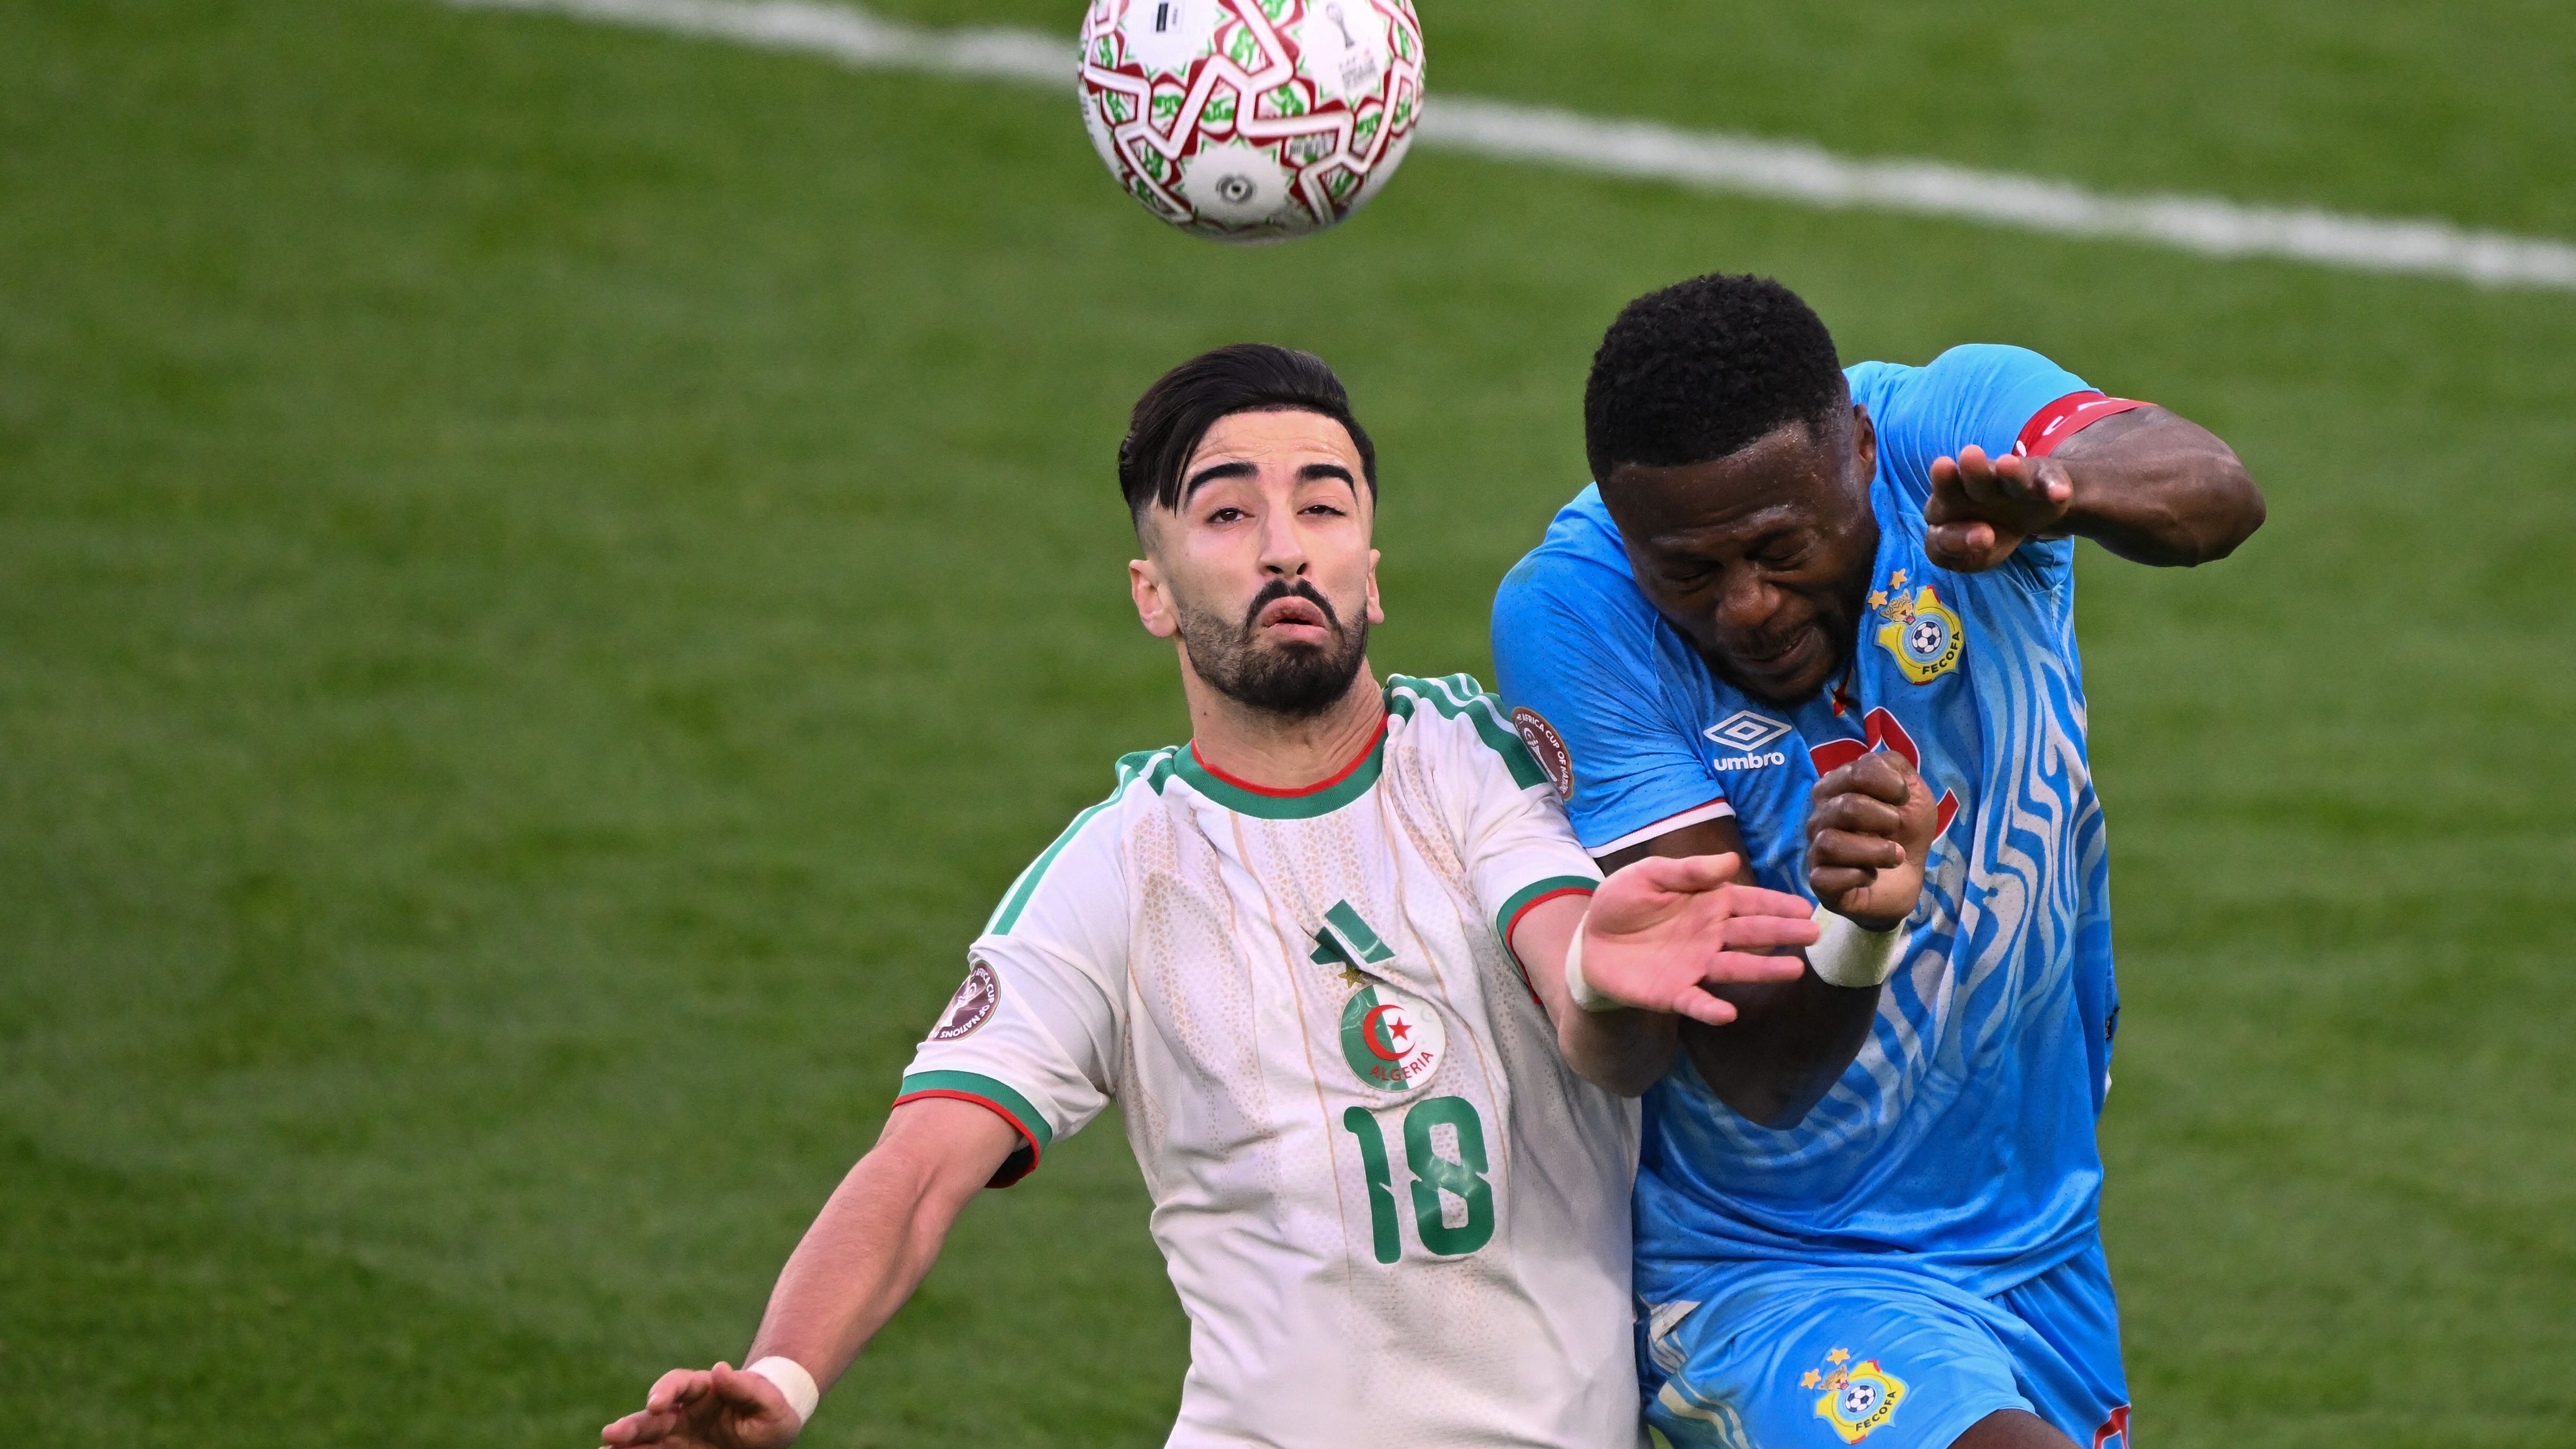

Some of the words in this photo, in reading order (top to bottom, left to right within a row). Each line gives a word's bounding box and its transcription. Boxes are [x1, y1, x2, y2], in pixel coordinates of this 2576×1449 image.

[1922, 631, 1960, 675] FECOFA
[1522, 713, 1544, 732] AFRICA
[1546, 730, 1560, 748] CUP
[1557, 751, 1566, 766] OF
[1714, 752, 1785, 771] umbro
[986, 984, 995, 1003] CUP
[979, 1004, 990, 1017] OF
[939, 1015, 980, 1038] NATIONS
[1369, 1052, 1434, 1081] ALGERIA
[1343, 1095, 1495, 1264] 18
[1856, 1391, 1896, 1432] FECOFA
